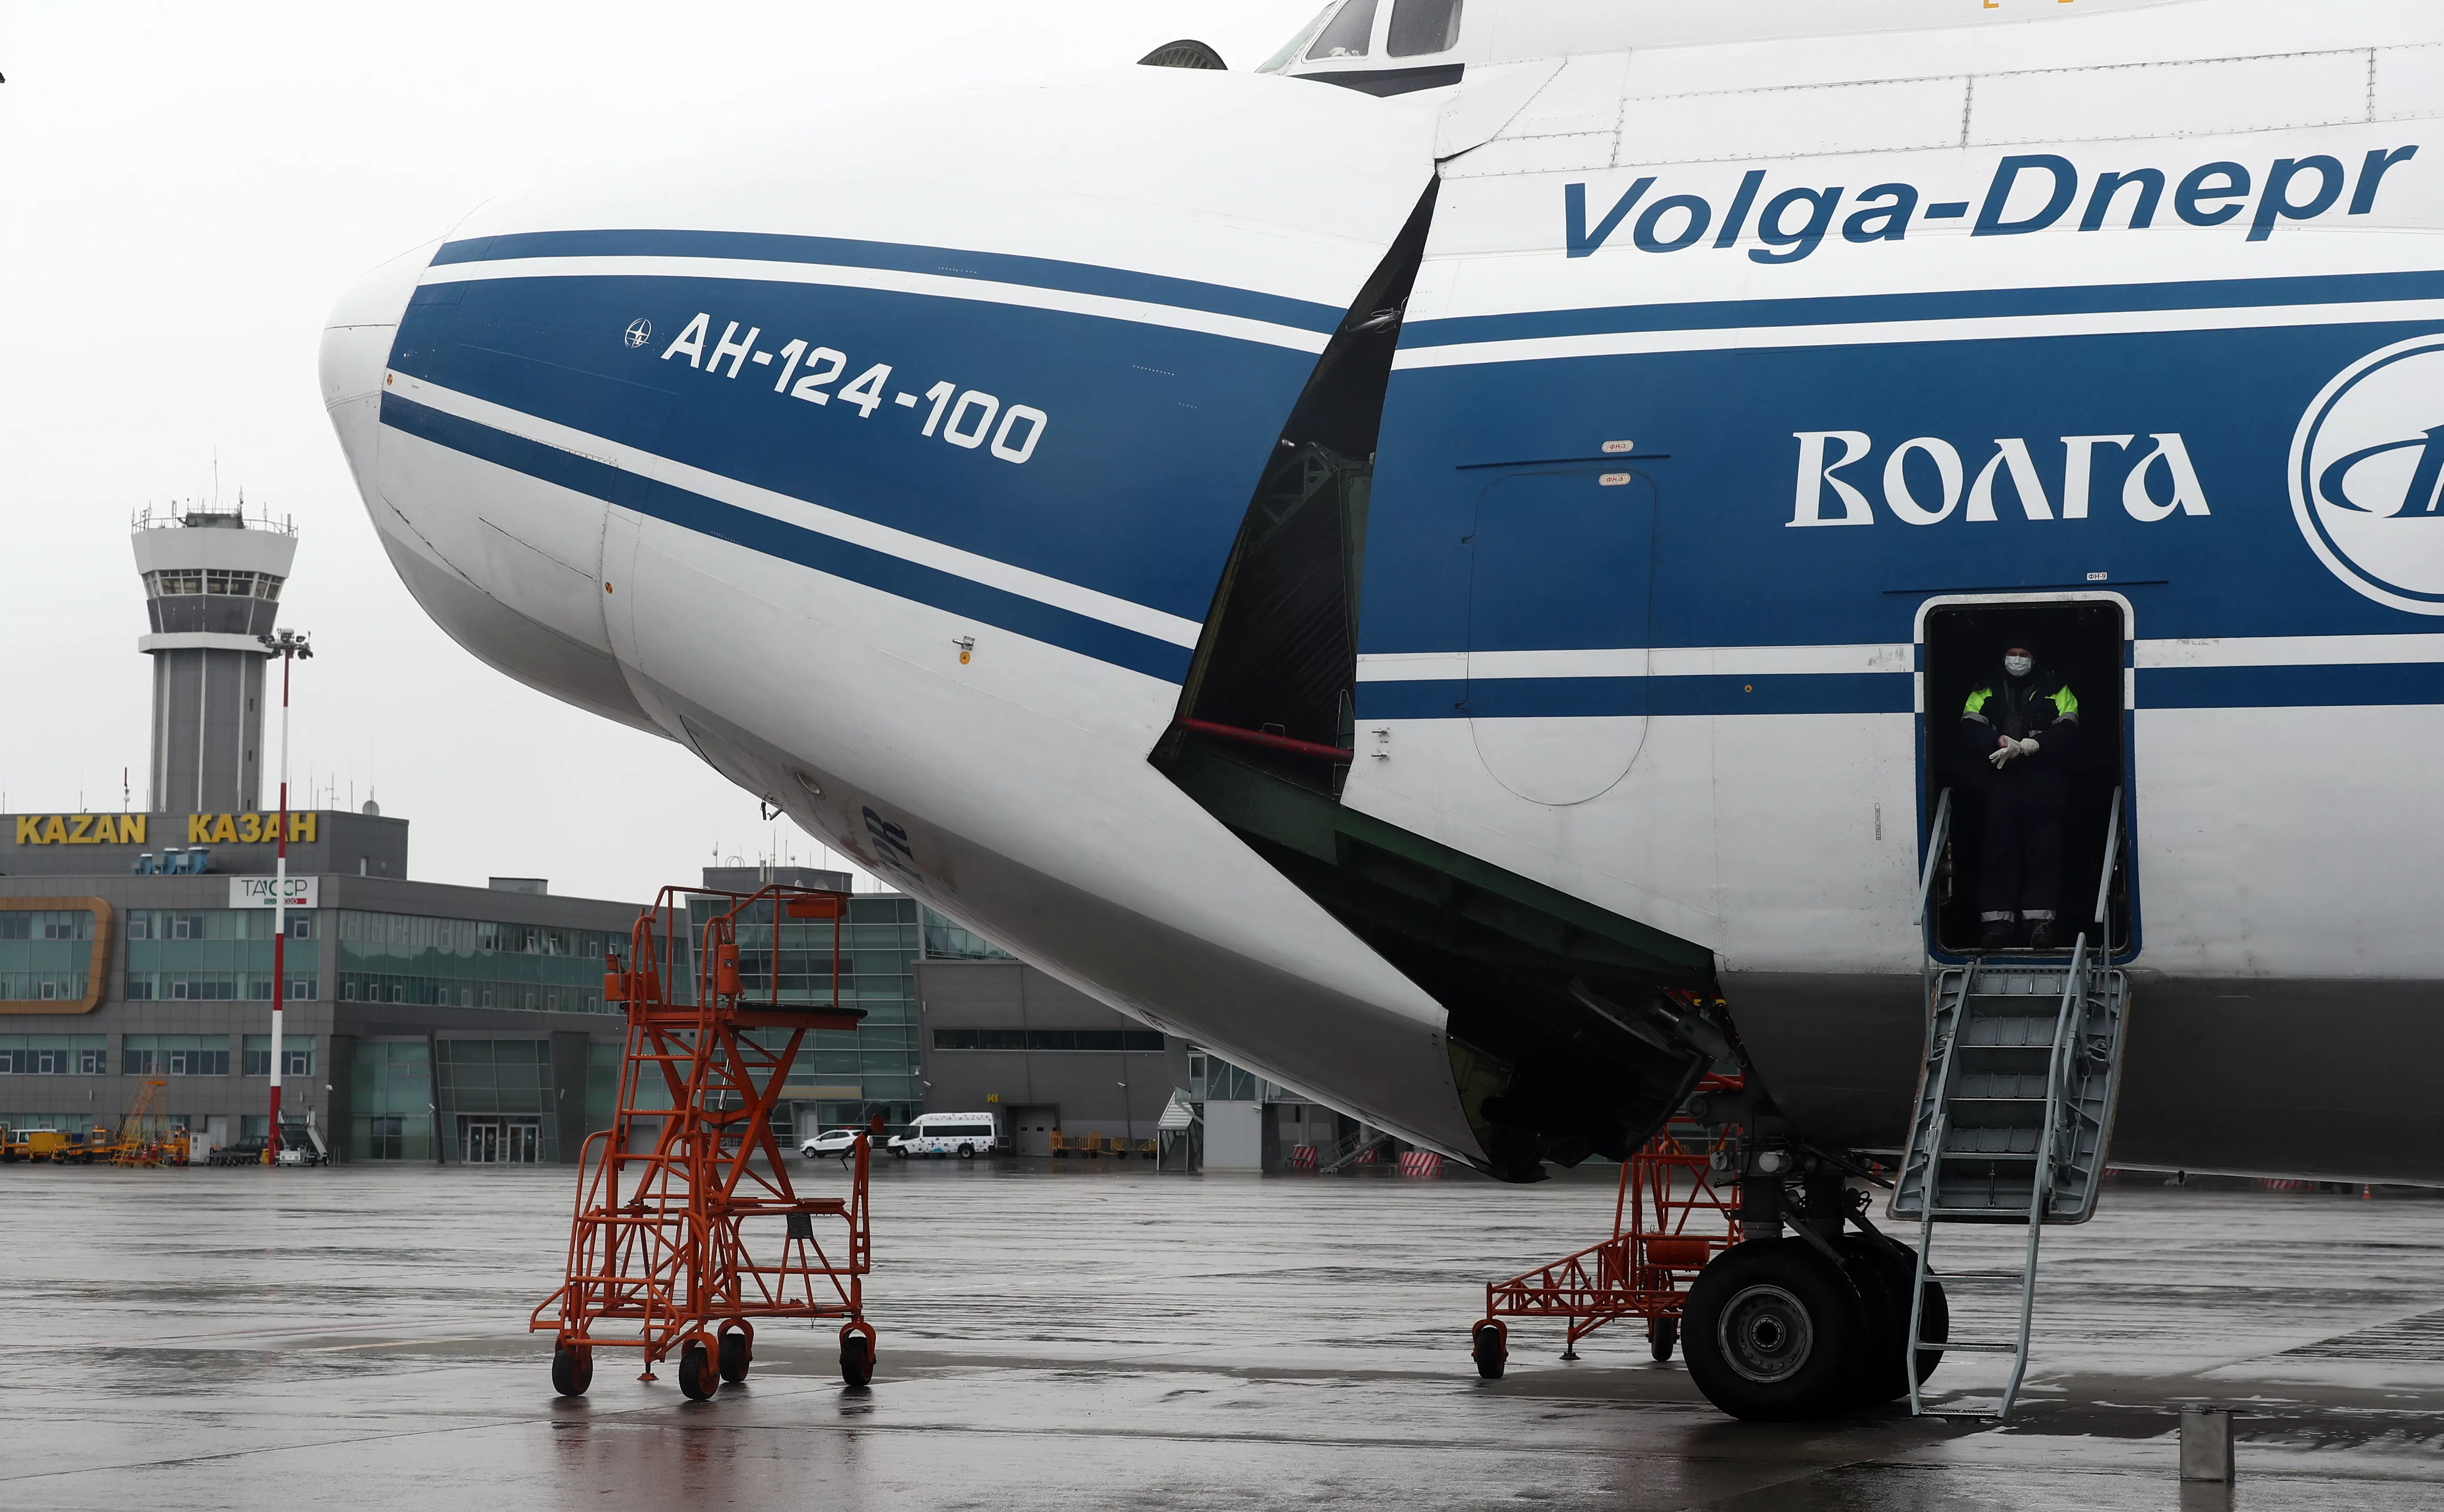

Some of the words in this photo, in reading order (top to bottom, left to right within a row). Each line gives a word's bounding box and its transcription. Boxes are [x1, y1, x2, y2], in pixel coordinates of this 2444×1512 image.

[1566, 145, 2419, 264] Volga-Dnepr
[16, 814, 146, 844] KAZAN
[188, 813, 316, 843] КАЗАН
